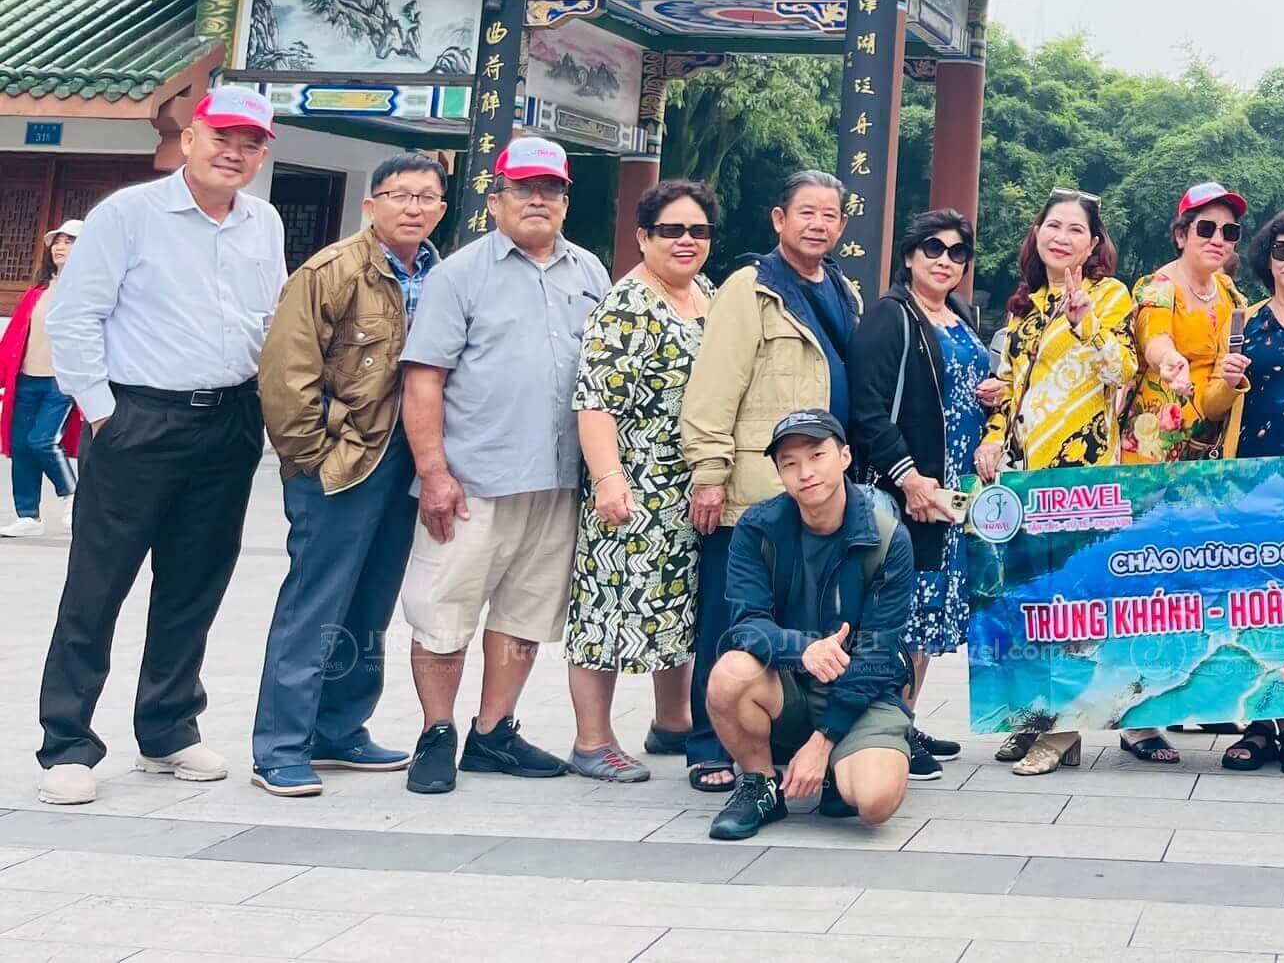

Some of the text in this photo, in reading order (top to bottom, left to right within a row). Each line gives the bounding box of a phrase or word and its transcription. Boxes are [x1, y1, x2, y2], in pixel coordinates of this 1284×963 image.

[1025, 484, 1132, 513] JTRAVEL
[1111, 548, 1180, 574] CHÀO
[1185, 544, 1256, 569] MỪNG
[1022, 594, 1106, 641] TRÙNG
[1112, 588, 1202, 636] KHÁNH
